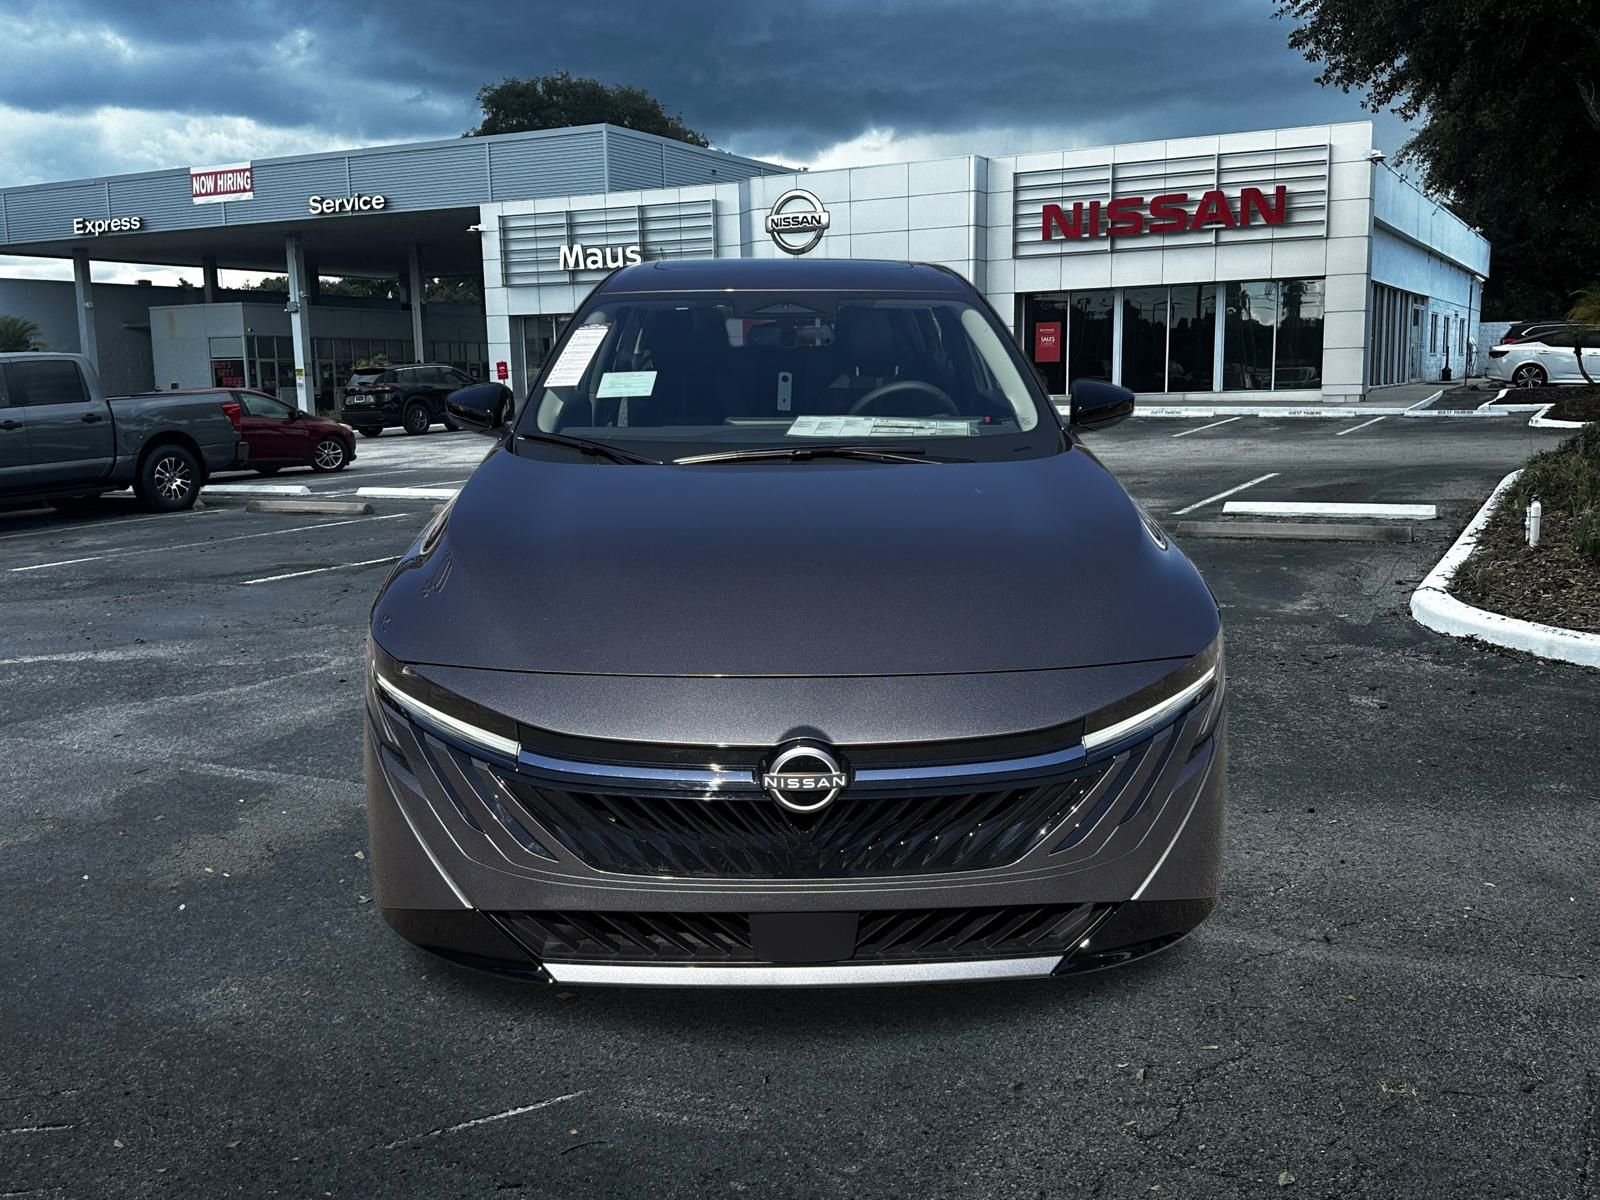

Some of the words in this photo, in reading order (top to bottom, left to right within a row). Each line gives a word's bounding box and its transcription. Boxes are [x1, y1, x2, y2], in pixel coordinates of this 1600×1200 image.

[193, 174, 215, 195] NOW
[217, 171, 251, 193] HIRING
[309, 193, 385, 214] Service
[1042, 185, 1287, 241] NISSAN
[73, 216, 141, 236] Express
[770, 215, 822, 228] NISSAN
[559, 243, 642, 271] Maus
[764, 775, 846, 789] NISSAN
